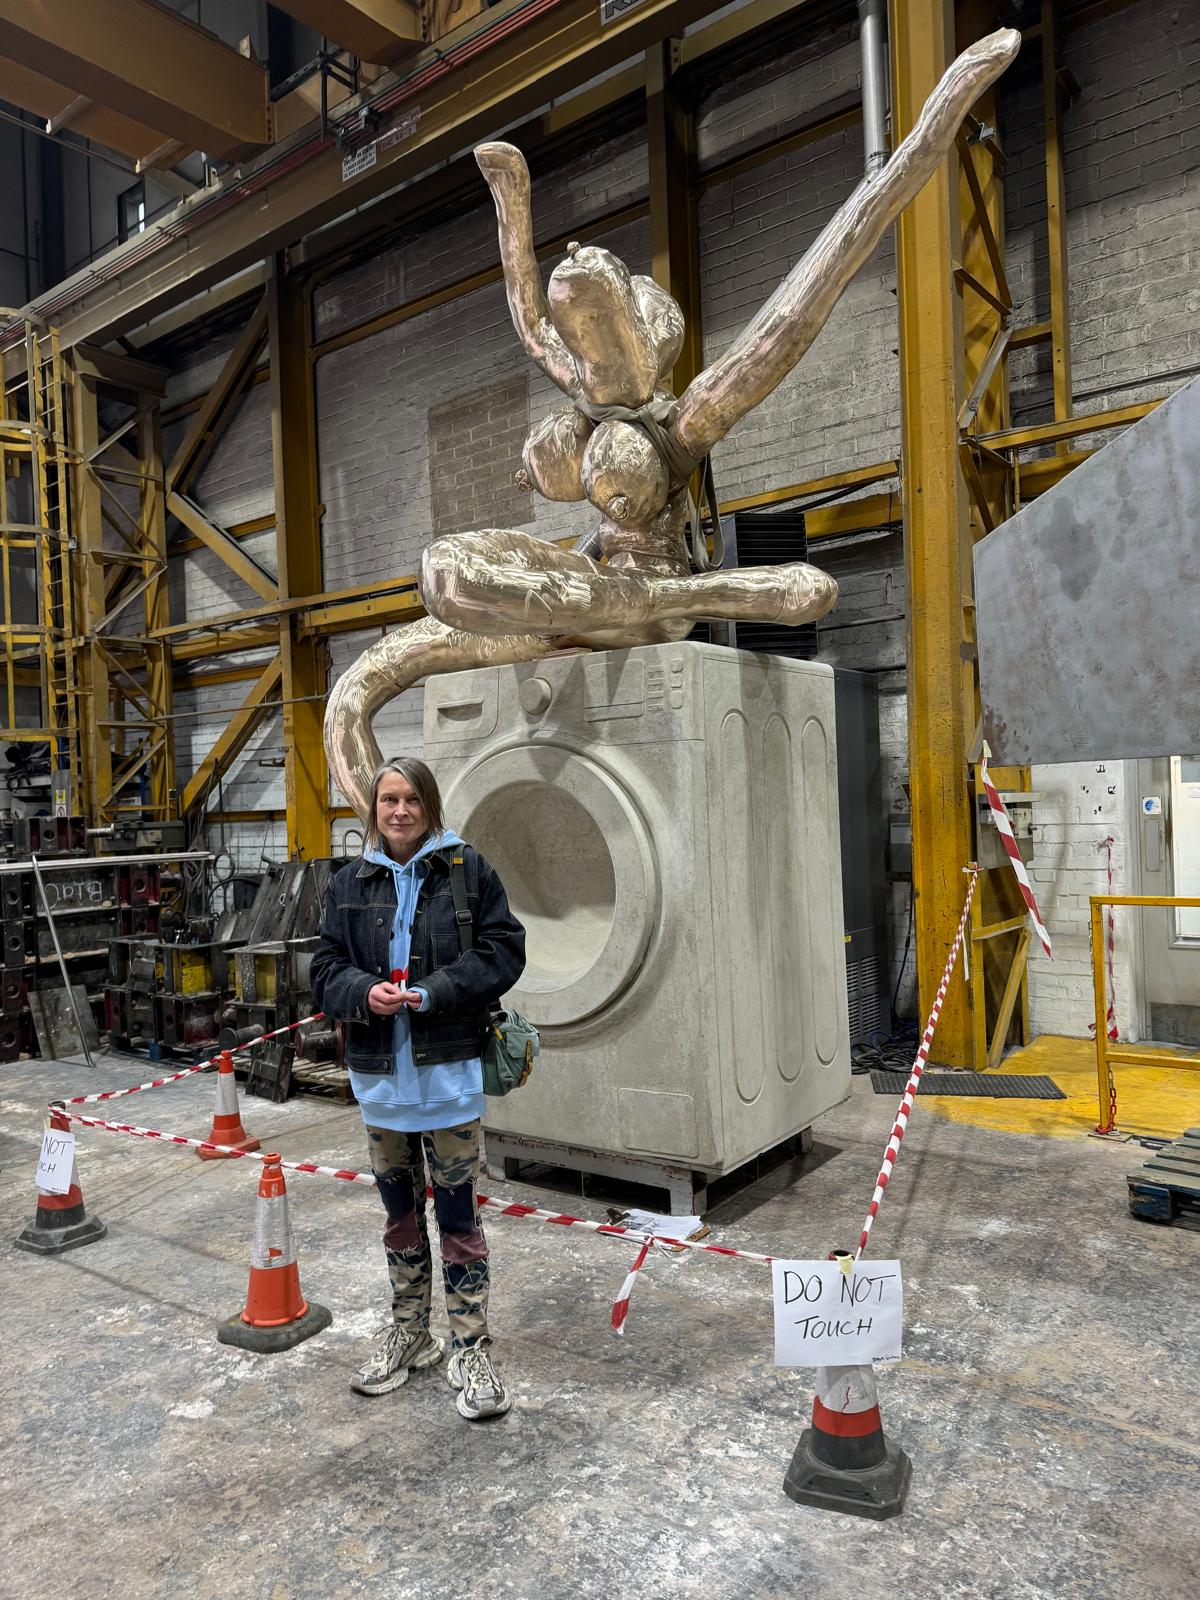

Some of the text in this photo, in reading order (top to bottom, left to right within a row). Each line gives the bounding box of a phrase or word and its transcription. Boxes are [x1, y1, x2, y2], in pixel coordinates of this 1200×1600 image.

[43, 1136, 73, 1156] NOT
[783, 1270, 897, 1307] DO NOT
[794, 1315, 873, 1339] TOUCH
